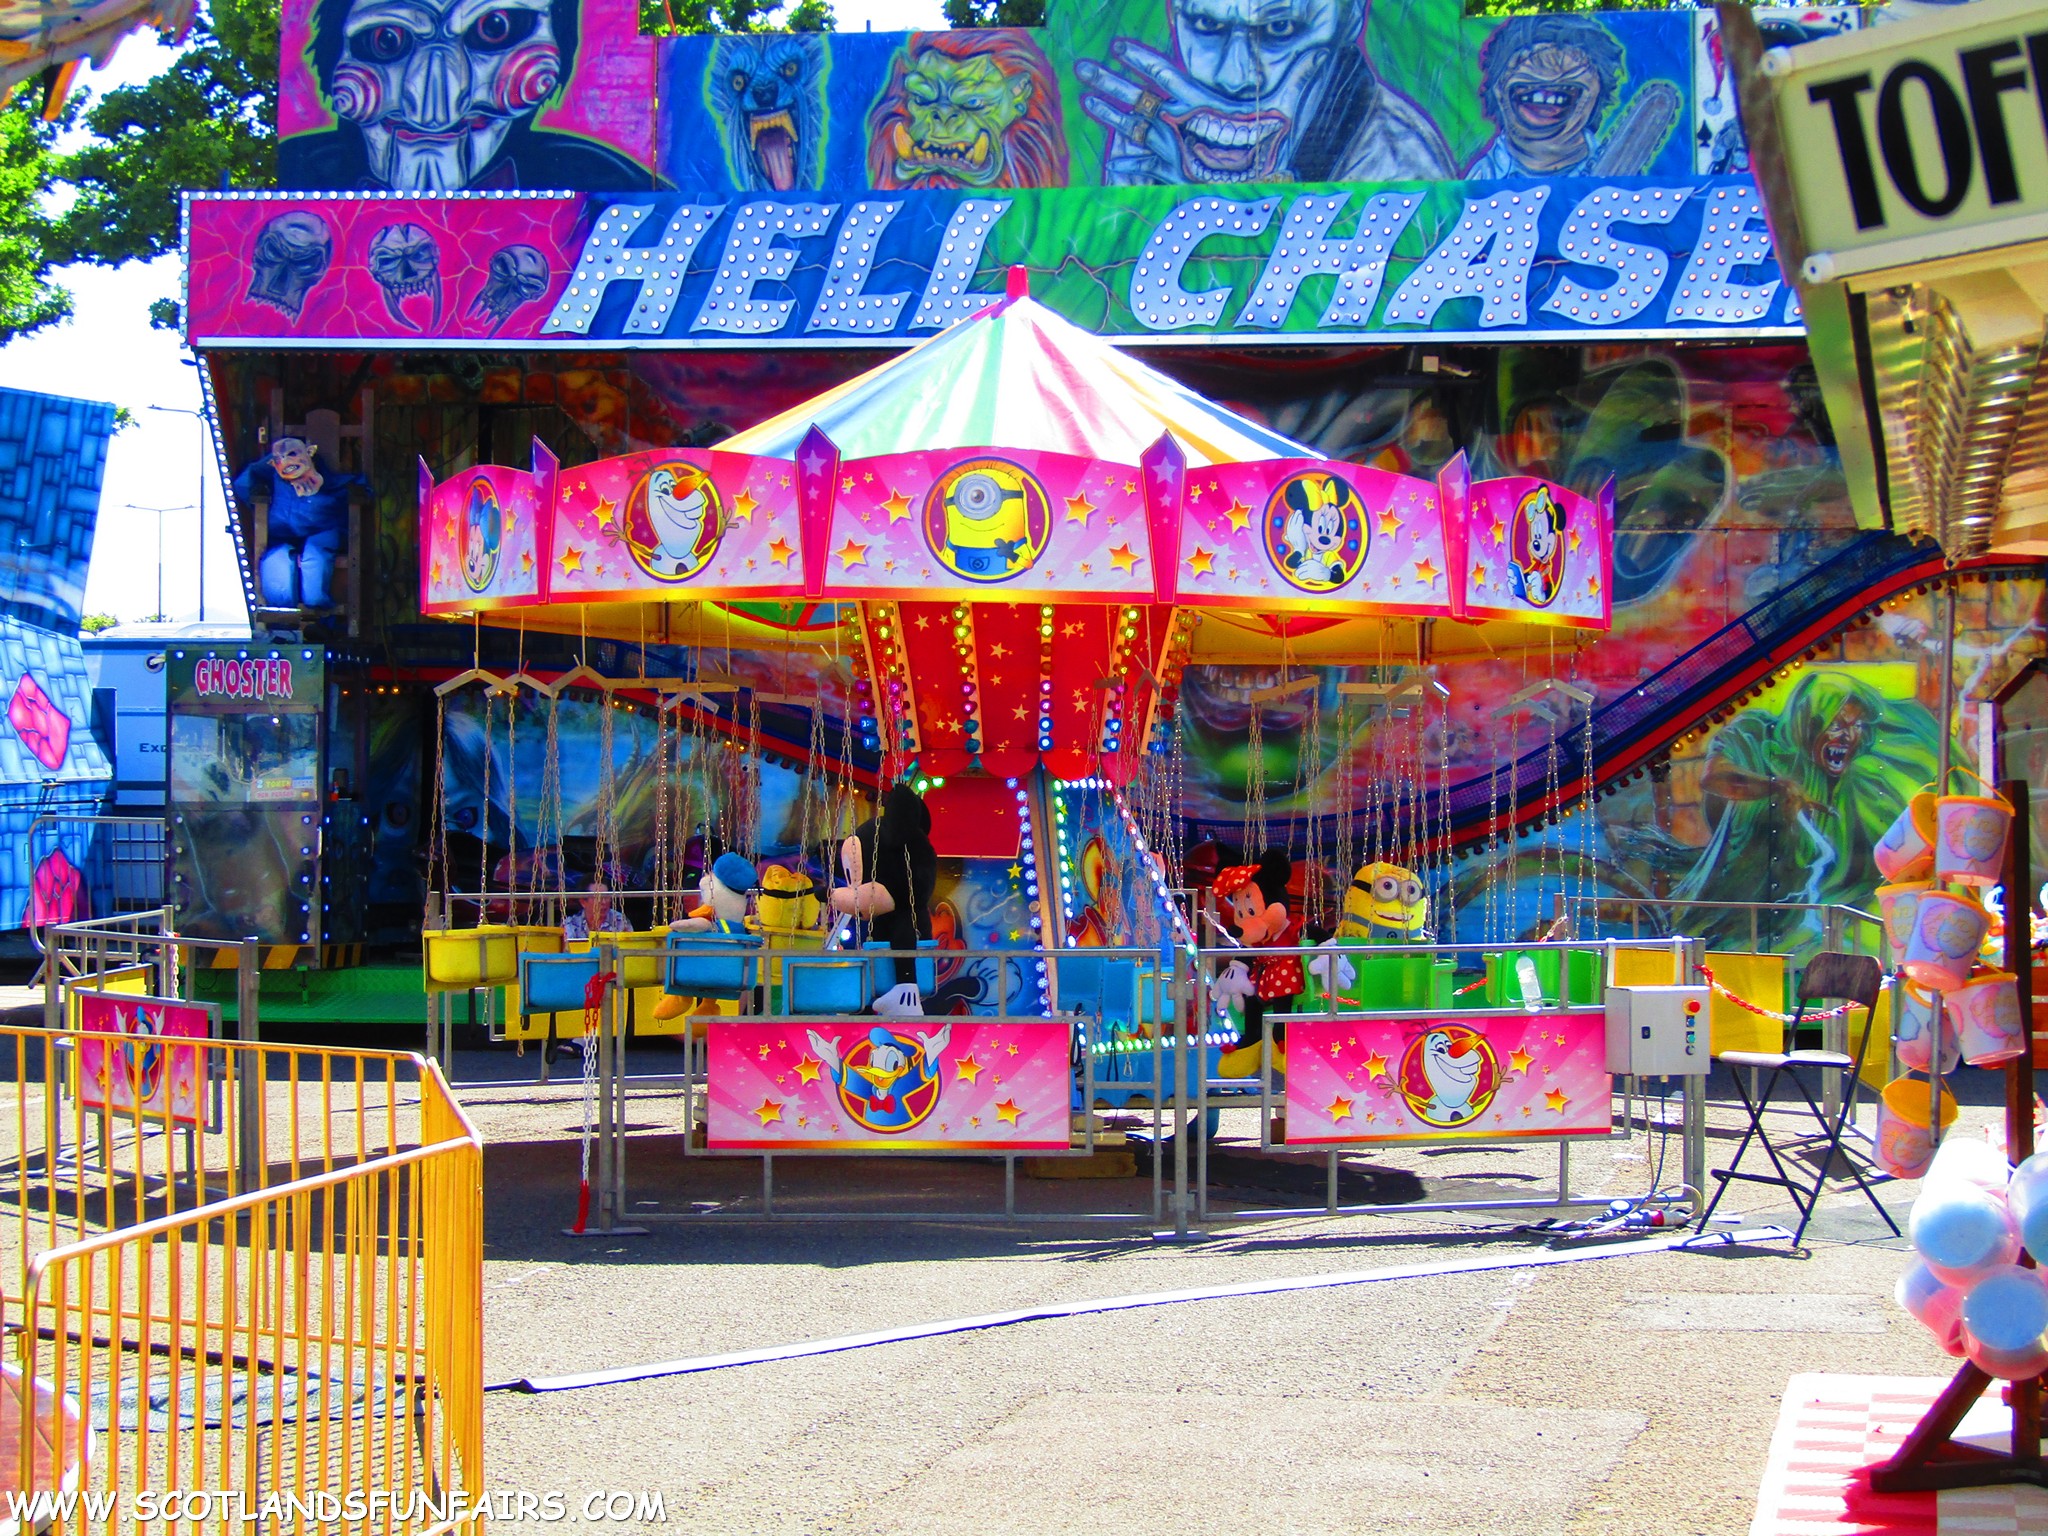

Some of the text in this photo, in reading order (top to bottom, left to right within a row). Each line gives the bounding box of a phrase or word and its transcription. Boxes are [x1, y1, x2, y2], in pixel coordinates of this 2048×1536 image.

[1806, 30, 2048, 233] TOF
[540, 184, 1804, 334] HELL CHASE
[194, 658, 294, 701] GHOSTER
